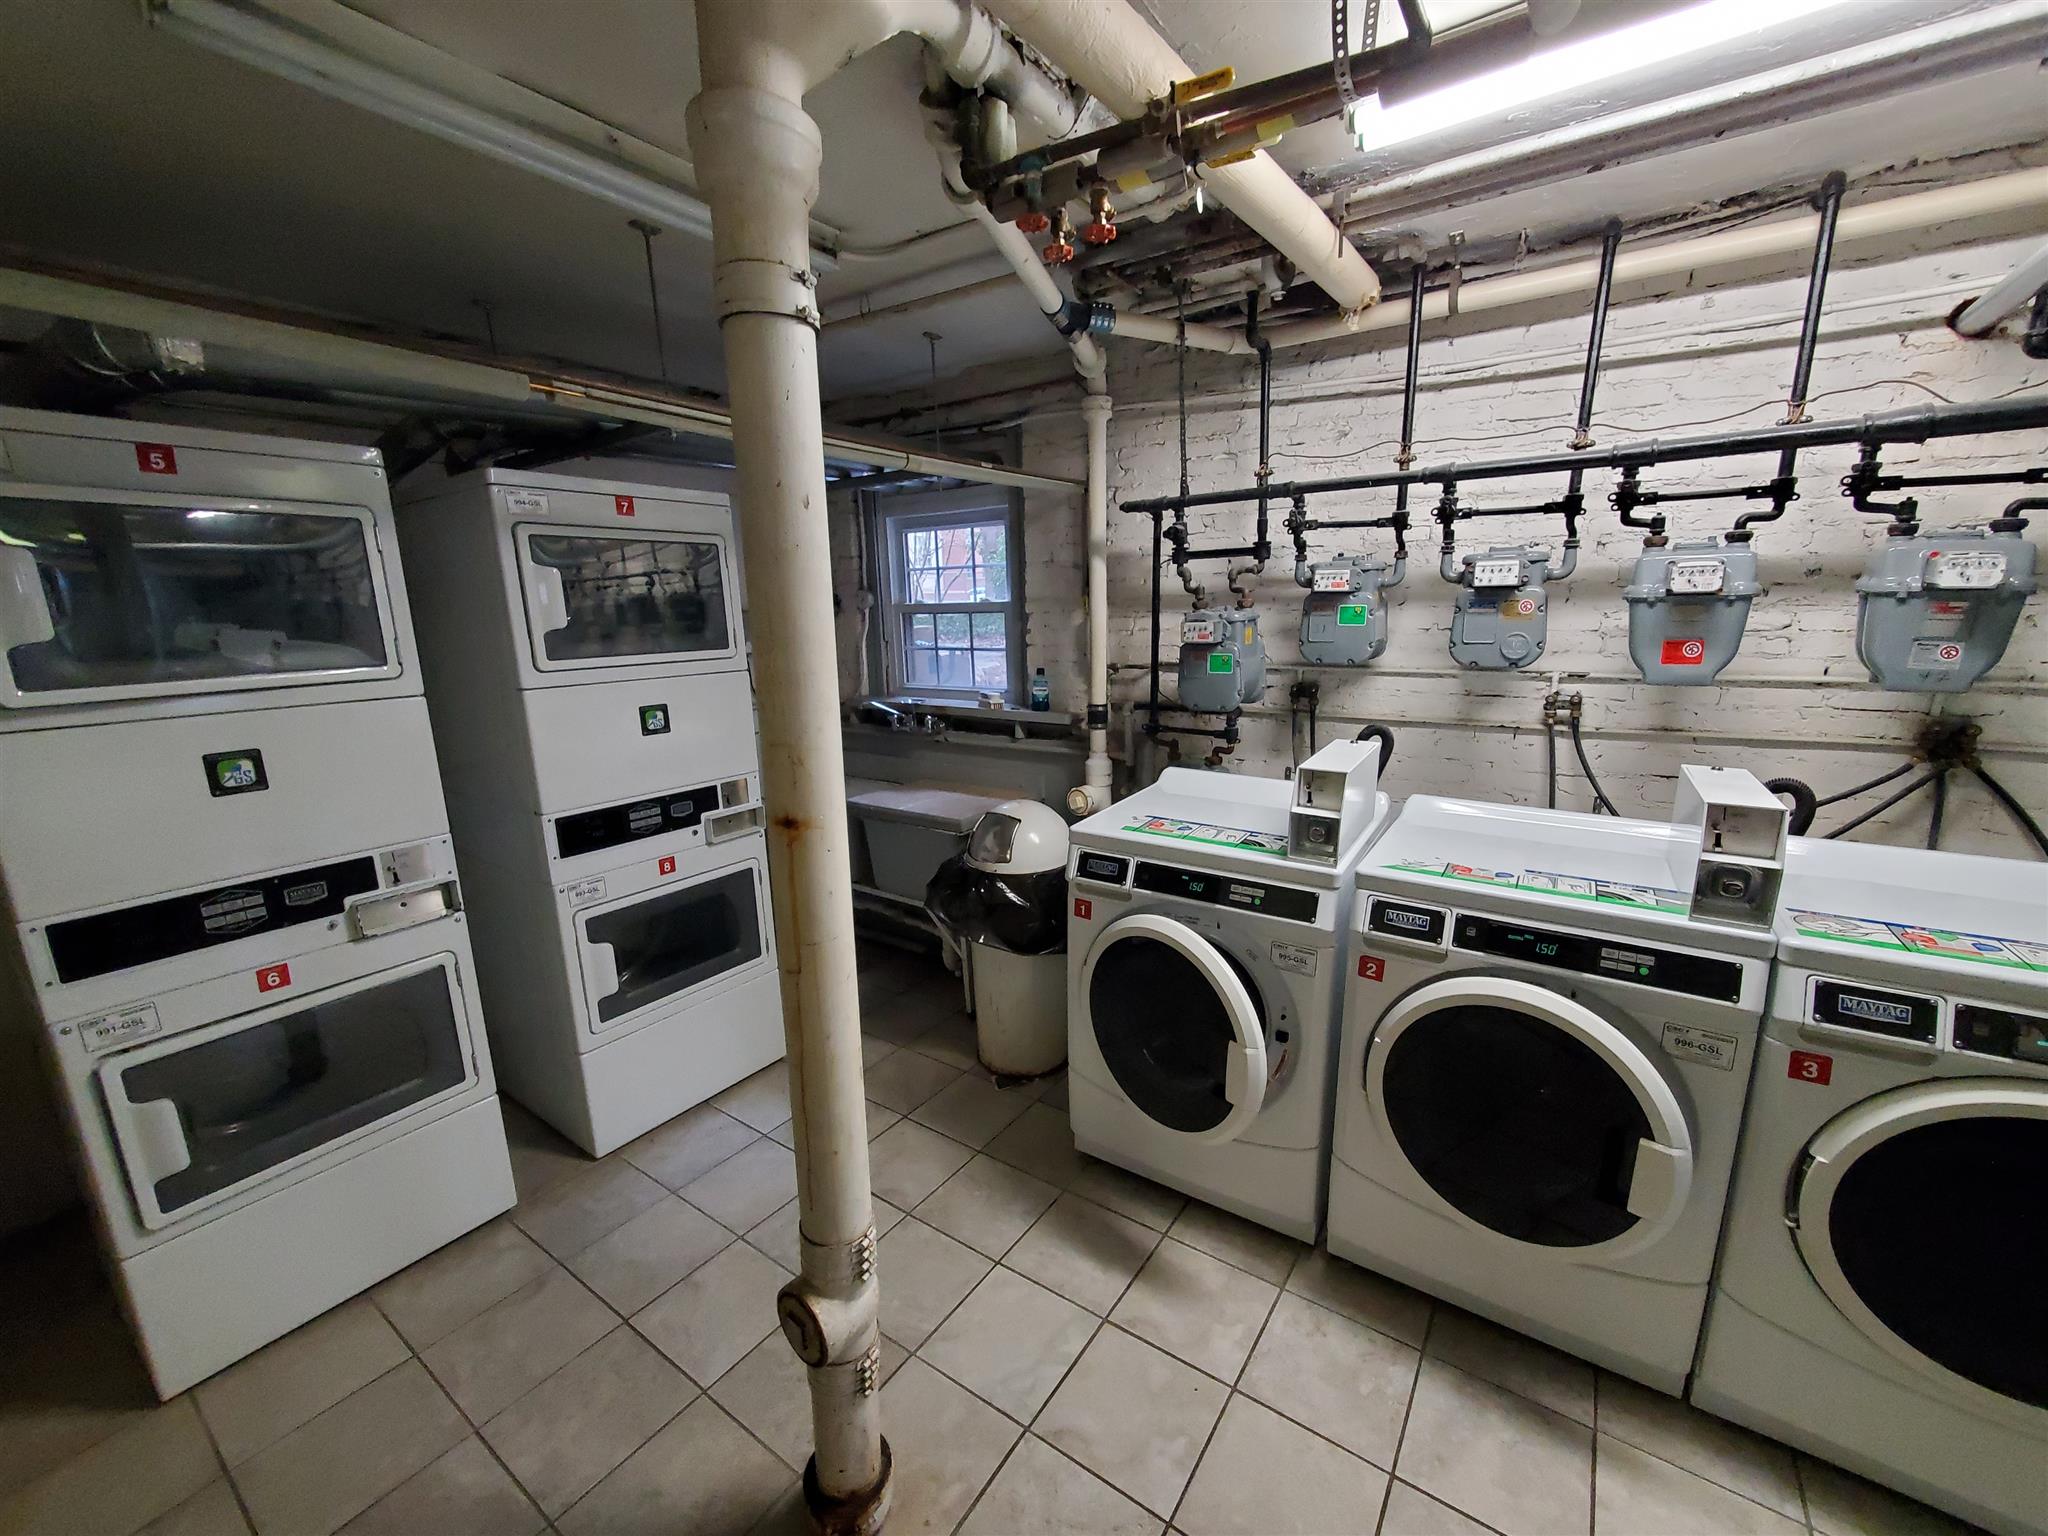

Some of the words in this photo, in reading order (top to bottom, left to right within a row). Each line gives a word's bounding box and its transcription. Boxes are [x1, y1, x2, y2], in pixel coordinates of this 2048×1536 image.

[150, 453, 165, 469] 5
[621, 502, 629, 513] 7
[664, 862, 671, 872] 8
[1080, 905, 1086, 916] 1
[1387, 911, 1427, 926] MAYTAG
[1366, 963, 1377, 977] 2
[267, 972, 281, 986] 6
[1843, 998, 1908, 1018] MAYTAG
[1674, 1037, 1723, 1056] 996-GSL
[1802, 1061, 1819, 1078] 3
